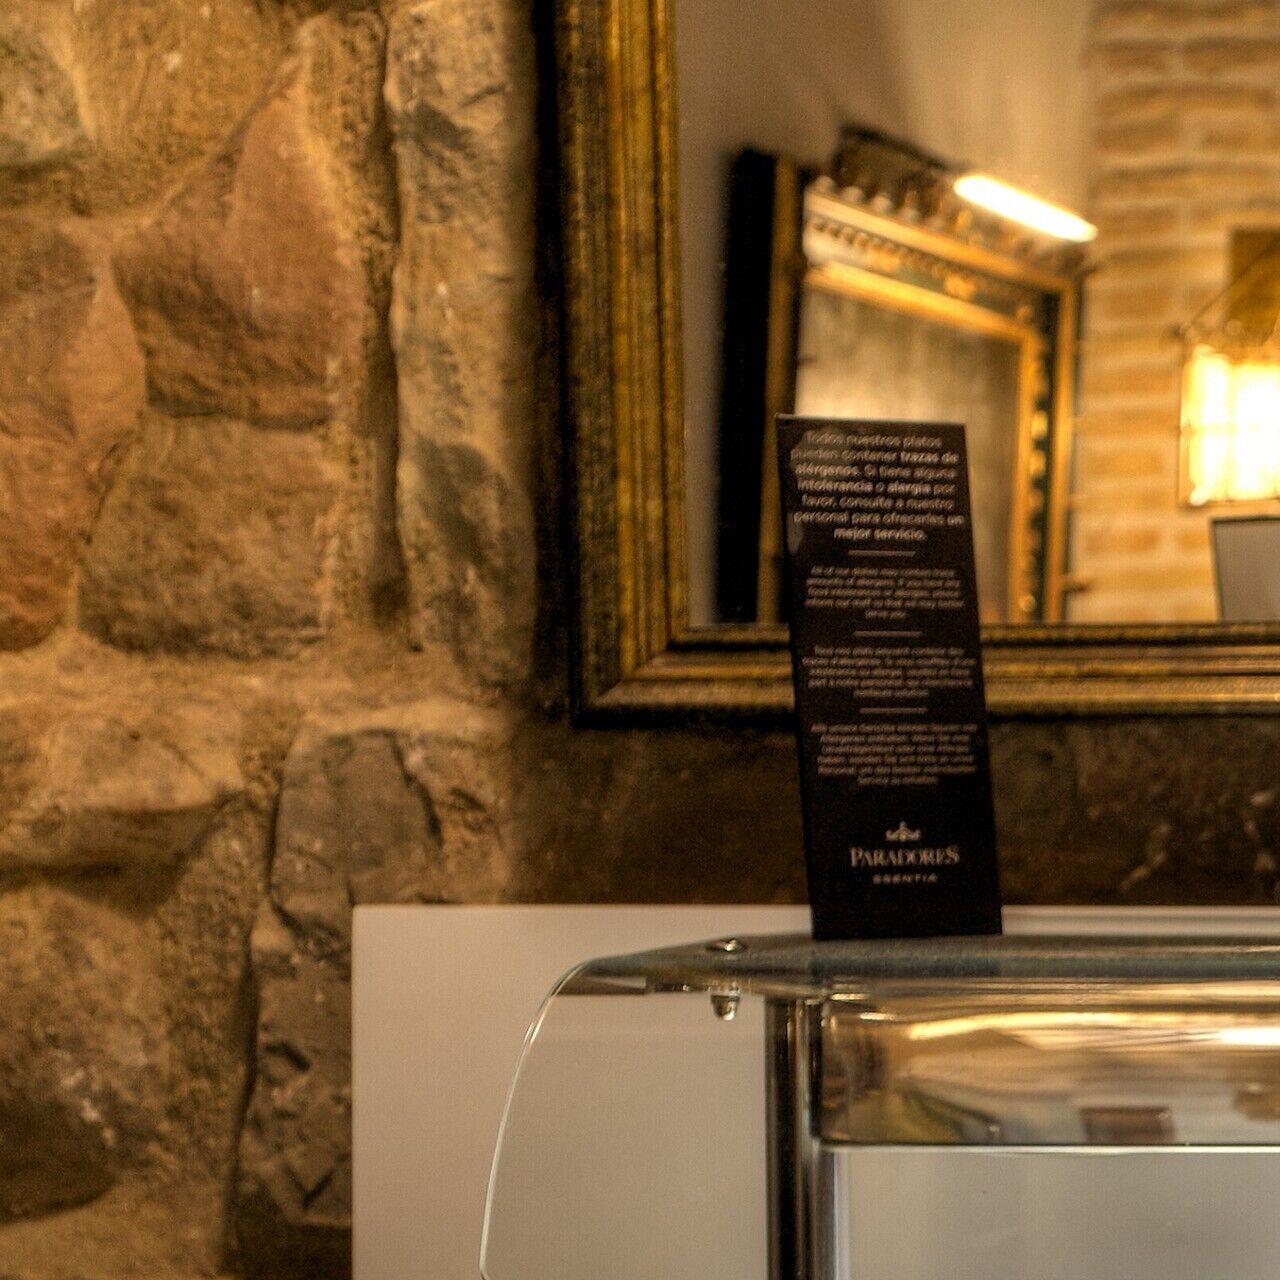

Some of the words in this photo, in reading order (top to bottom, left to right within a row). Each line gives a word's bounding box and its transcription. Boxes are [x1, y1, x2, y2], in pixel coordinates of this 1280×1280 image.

[903, 435, 943, 448] platos
[841, 450, 897, 461] contener
[900, 451, 939, 462] trazas
[941, 451, 959, 464] de
[879, 465, 912, 478] tiene
[914, 466, 957, 481] alguna
[797, 478, 873, 492] intolerancia
[875, 481, 885, 493] o
[887, 480, 931, 496] alergia
[933, 483, 956, 496] por
[839, 495, 894, 508] consulte
[895, 498, 904, 509] a
[906, 497, 955, 511] nuestro
[793, 511, 849, 525] personal
[851, 513, 881, 526] para
[947, 515, 965, 526] un
[834, 528, 872, 542] mejor
[873, 528, 928, 542] servicio.
[850, 846, 961, 868] PARADORES
